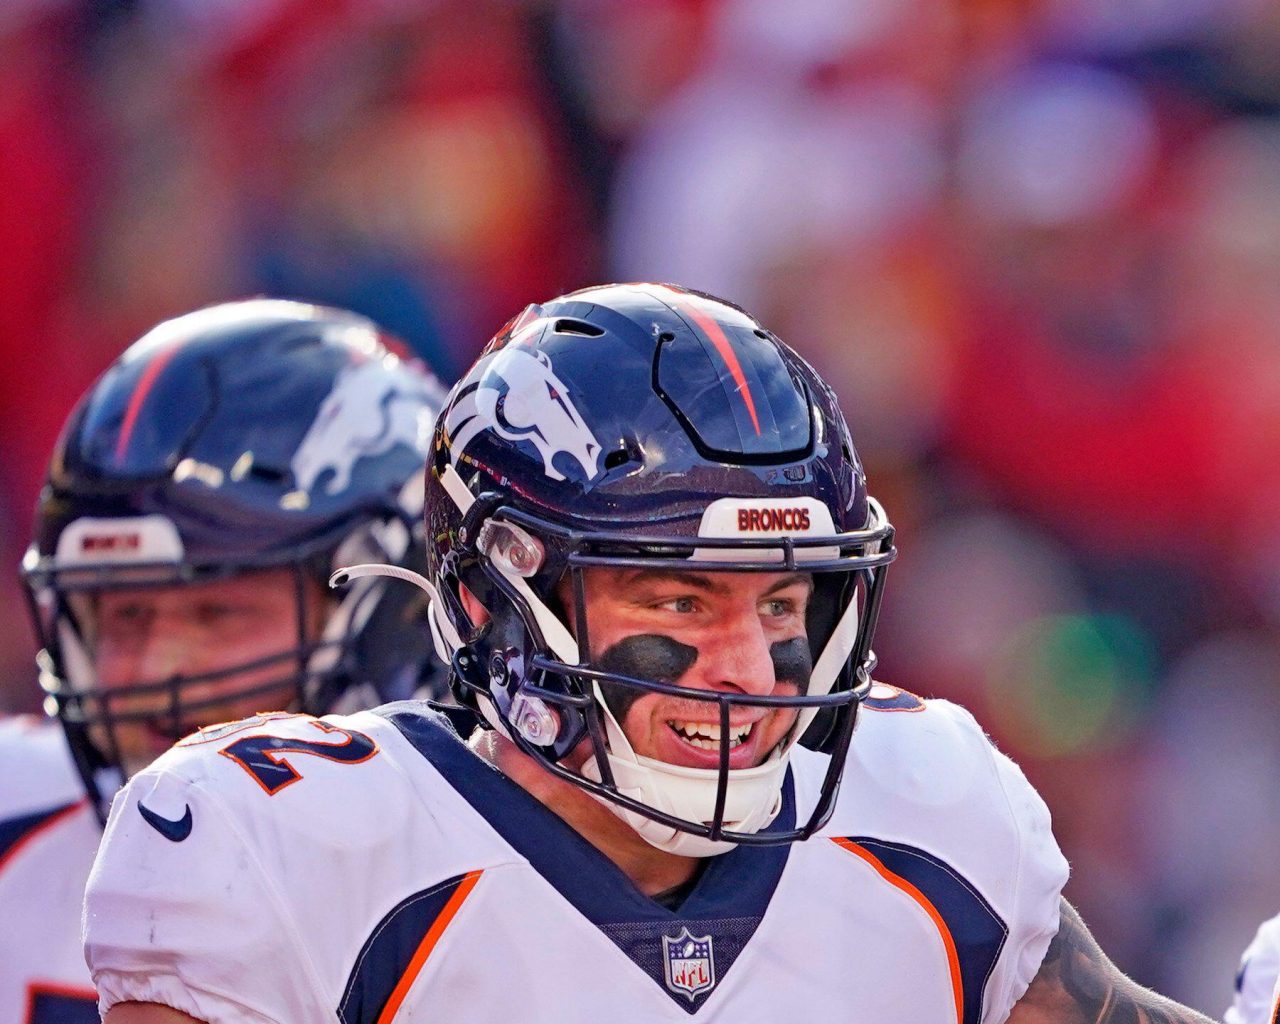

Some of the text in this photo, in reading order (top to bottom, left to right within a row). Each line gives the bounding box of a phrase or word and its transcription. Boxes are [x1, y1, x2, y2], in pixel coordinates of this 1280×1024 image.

[737, 507, 811, 531] BRONCOS
[175, 711, 380, 796] 2
[674, 960, 709, 988] NFL
